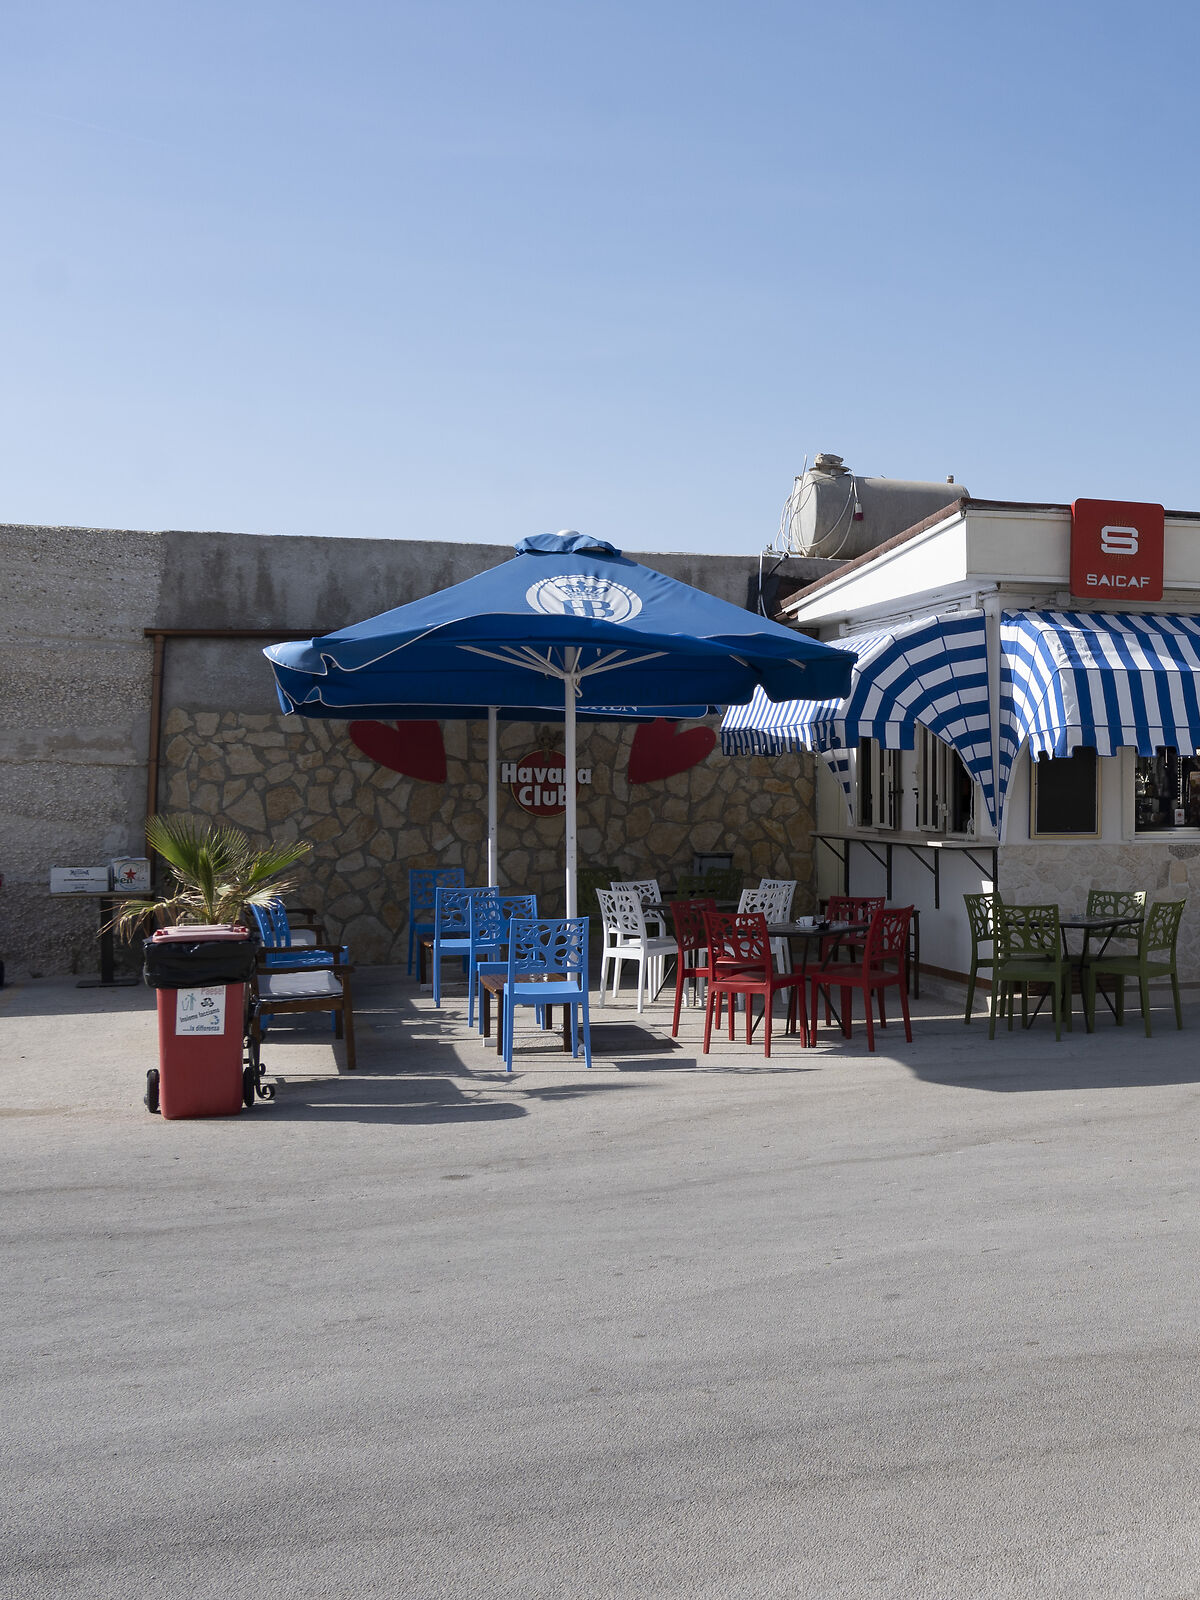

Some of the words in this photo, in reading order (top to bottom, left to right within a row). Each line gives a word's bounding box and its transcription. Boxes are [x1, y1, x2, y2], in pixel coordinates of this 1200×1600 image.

[1101, 525, 1139, 555] S
[1086, 573, 1150, 588] SAICAF
[501, 763, 592, 785] Havaa
